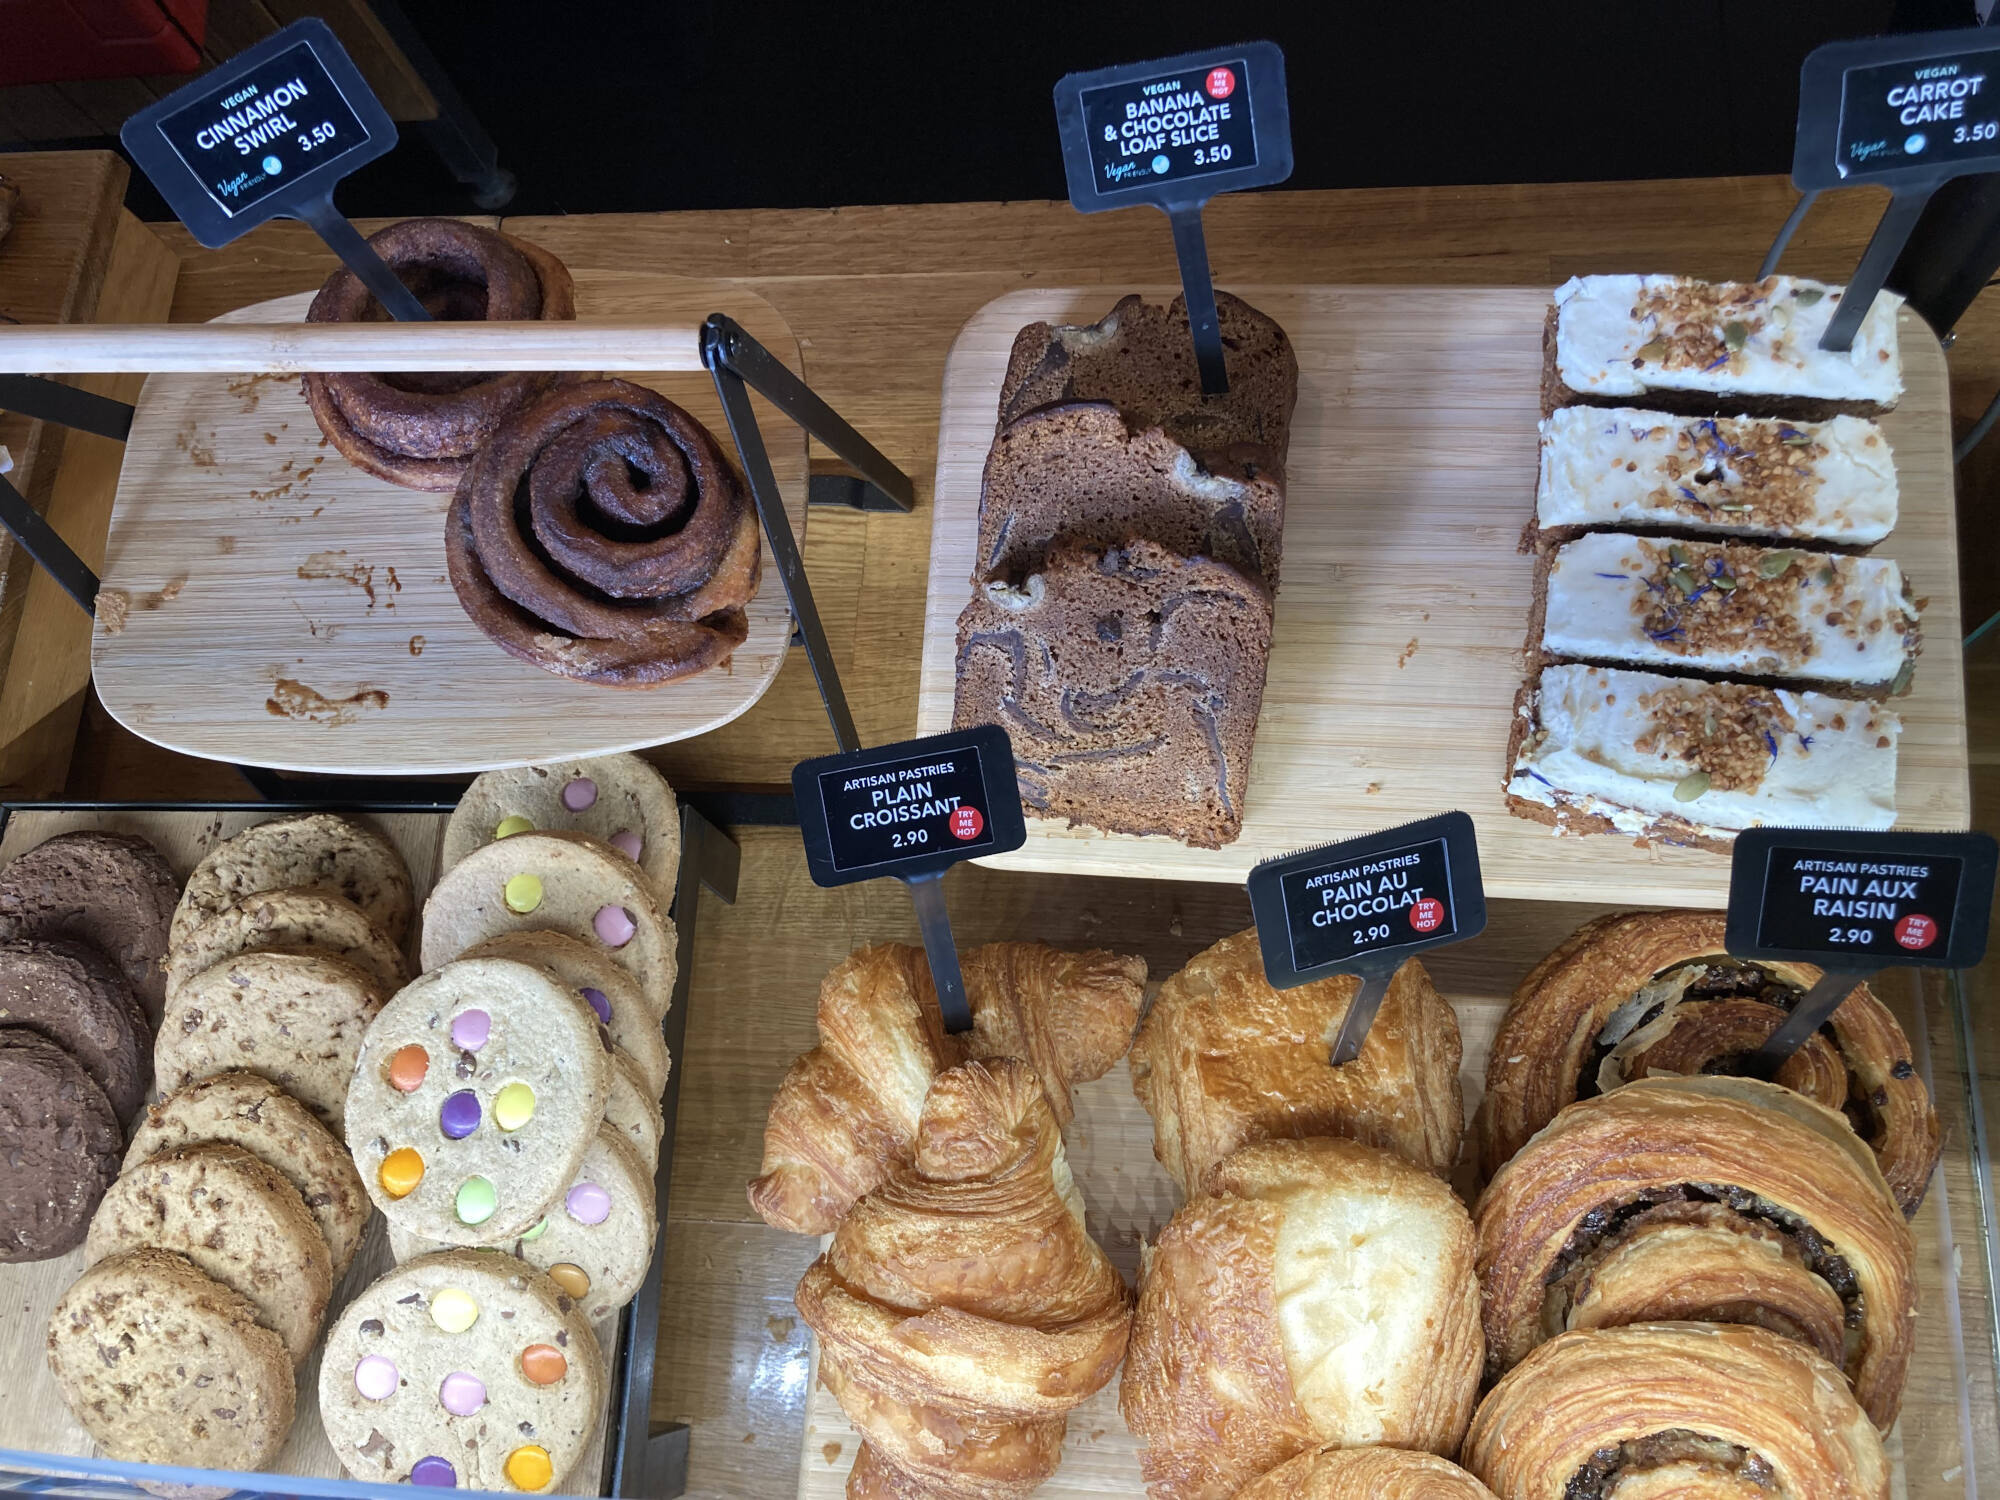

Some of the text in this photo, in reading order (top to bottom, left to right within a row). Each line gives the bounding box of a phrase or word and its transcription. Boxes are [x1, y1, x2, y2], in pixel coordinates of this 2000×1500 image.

[1213, 72, 1227, 80] TRY
[1915, 65, 1959, 80] VEGAN
[220, 84, 258, 110] VEGAN
[1143, 80, 1181, 96] VEGAN
[1212, 87, 1229, 95] HOT
[1887, 76, 1985, 107] CARROT
[196, 78, 308, 149] CINNAMON
[1125, 90, 1204, 119] BANANA
[1900, 100, 1965, 126] CAKE
[1104, 103, 1231, 142] & CHOCOLATE
[1953, 122, 1998, 144] 3.50
[234, 113, 297, 155] SWIRL
[298, 122, 336, 152] 3.50
[1120, 124, 1220, 156] LOAF SLICE
[1194, 144, 1232, 165] 3.50
[1850, 141, 1887, 161] Vegan
[1104, 161, 1136, 182] Vegan
[217, 172, 248, 197] Vegan
[843, 762, 955, 791] ARTISAN PASTRIES
[872, 782, 933, 807] PLAIN
[850, 796, 961, 830] CROISSANT
[957, 810, 974, 818] TRY
[959, 819, 973, 827] ME
[892, 829, 928, 848] 2.90
[957, 828, 976, 836] HOT
[1305, 853, 1420, 889] ARTISAN PASTRIES
[1793, 860, 1929, 878] ARTISAN PASTRIES
[1322, 871, 1408, 906] PAIN AU
[1800, 876, 1917, 899] PAIN AUX
[1312, 888, 1424, 927] CHOCOLAT
[1418, 902, 1435, 911] TRY
[1419, 911, 1433, 919] ME
[1813, 899, 1896, 920] RAISIN
[1416, 919, 1436, 928] HOT
[1906, 928, 1924, 937] ME
[1908, 918, 1929, 928] TRY
[1353, 924, 1390, 945] 2.90
[1828, 927, 1873, 944] 2.90
[1900, 936, 1925, 946] HOT
